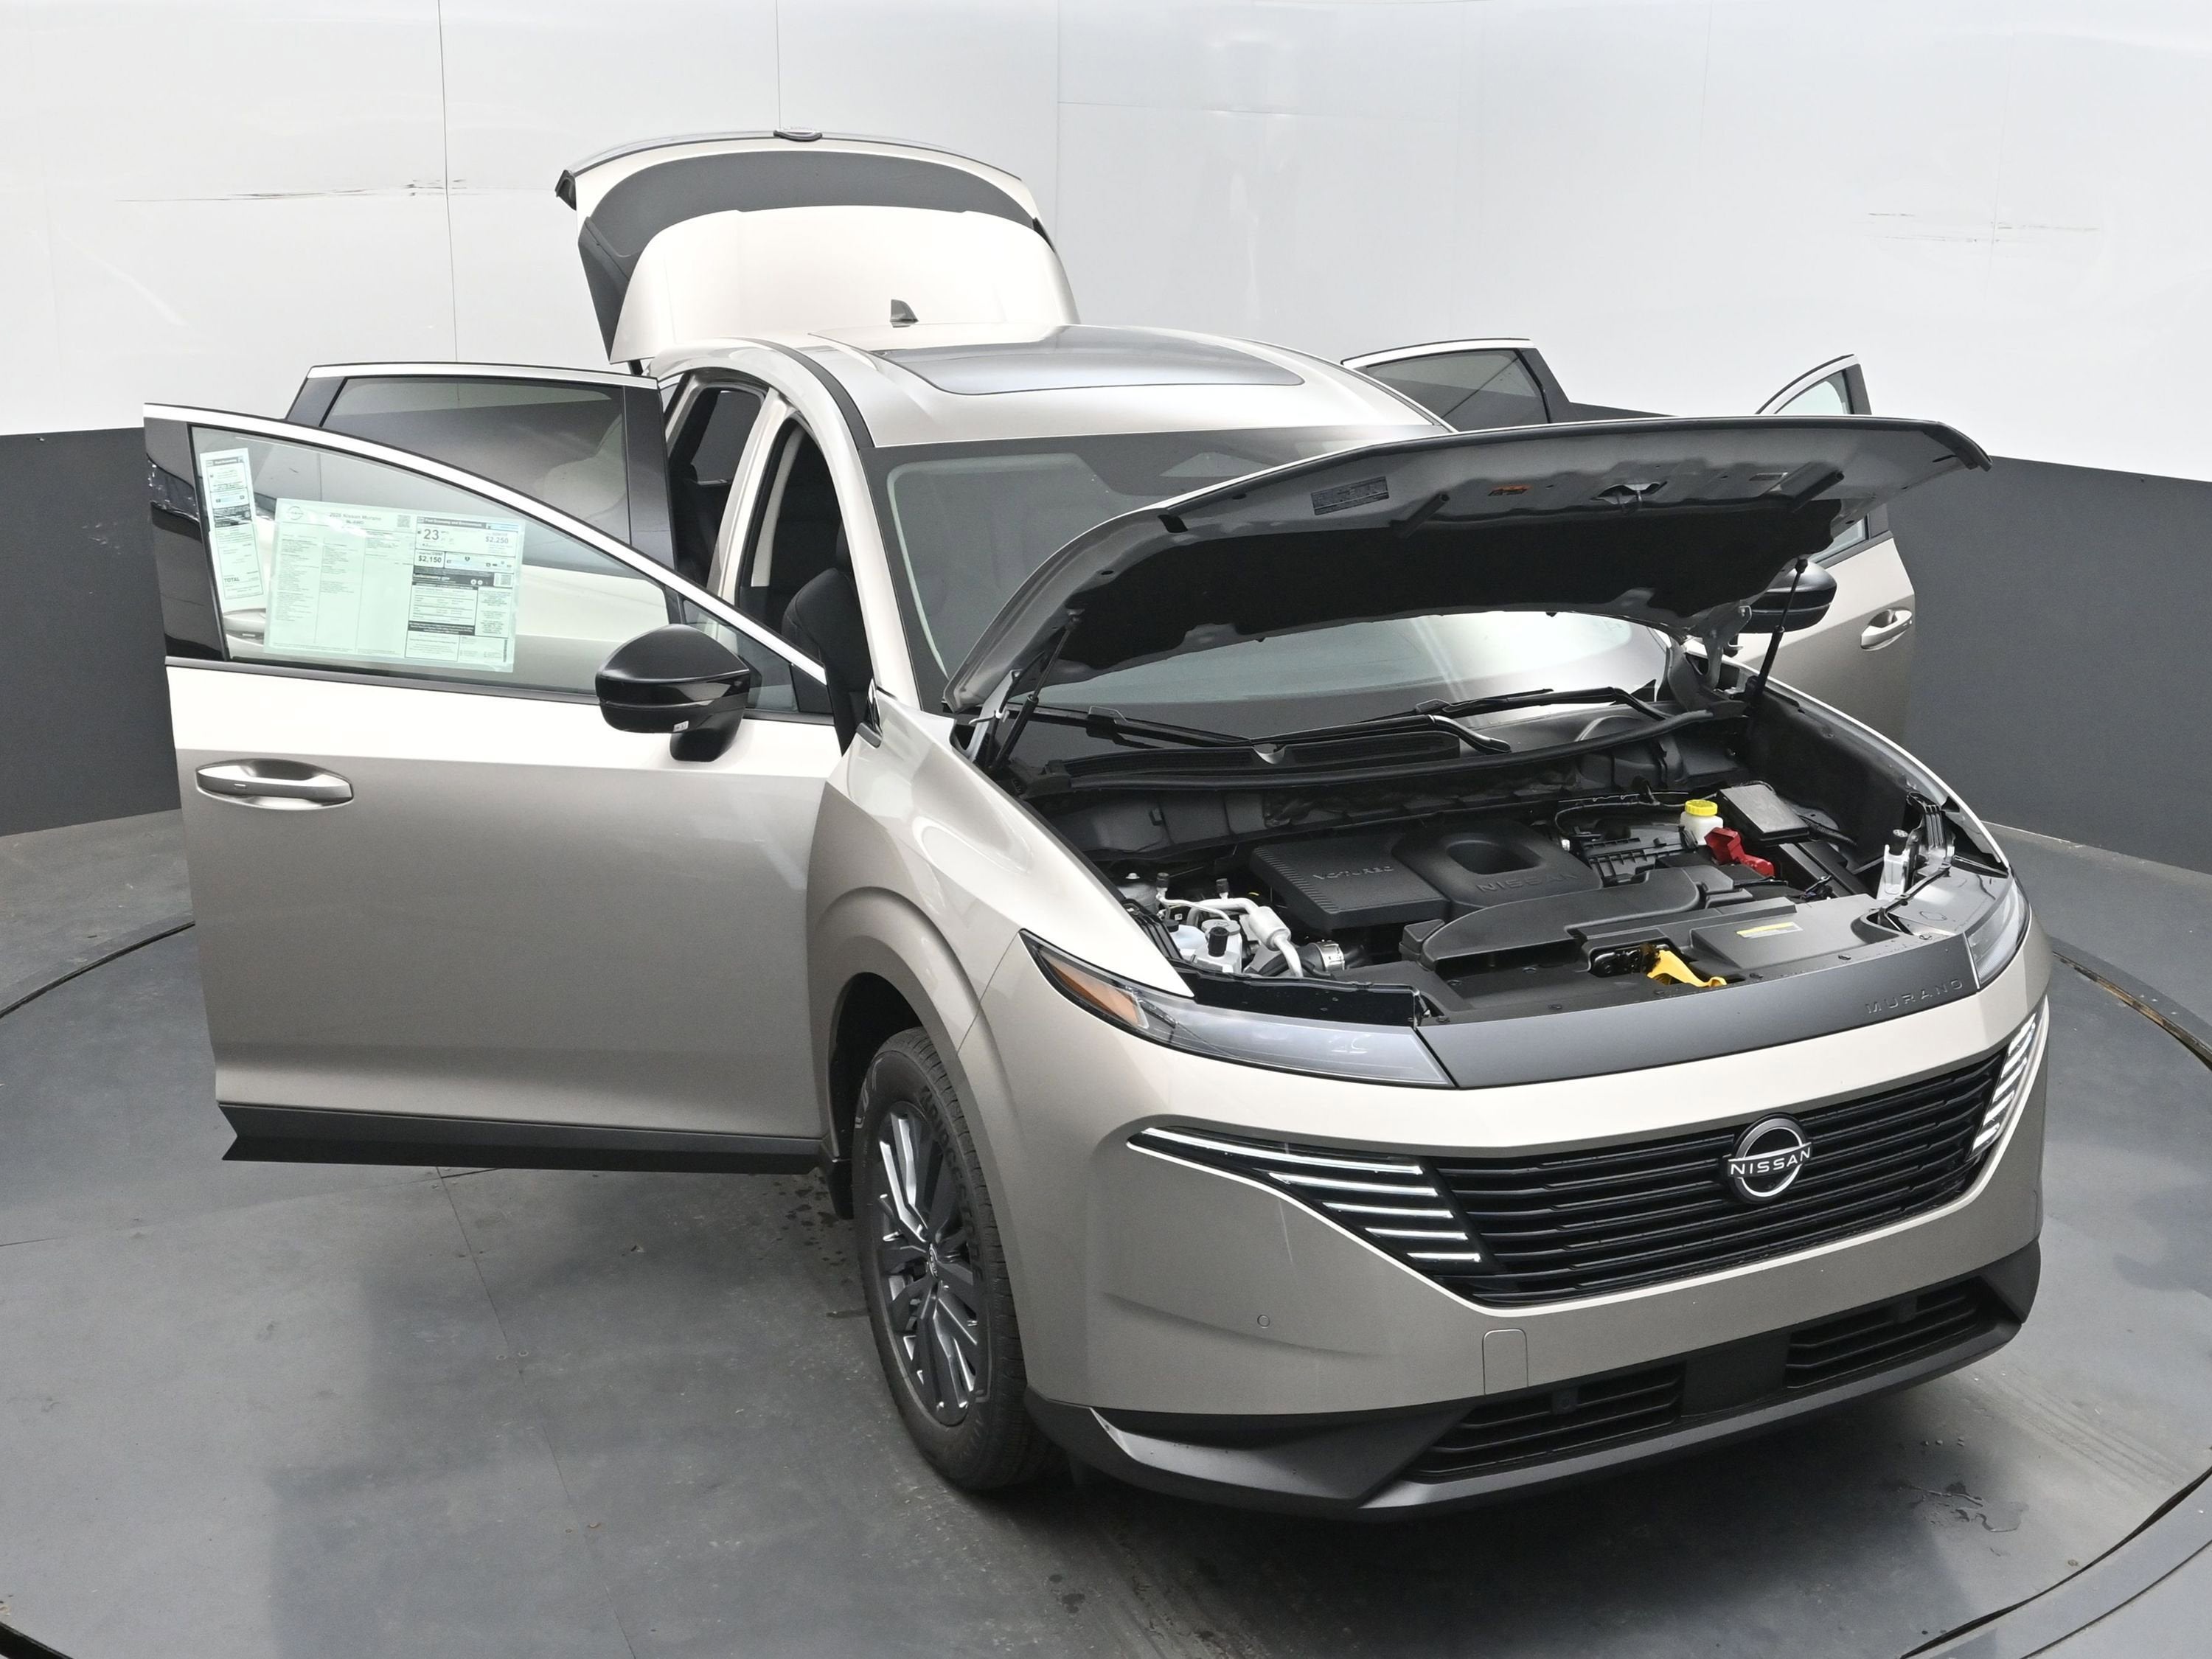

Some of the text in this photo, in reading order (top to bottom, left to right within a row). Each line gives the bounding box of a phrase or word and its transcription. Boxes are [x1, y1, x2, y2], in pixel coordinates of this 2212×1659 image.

[423, 529, 439, 540] 23
[1864, 978, 1964, 1015] MURANO
[1730, 1147, 1811, 1175] NISSAN
